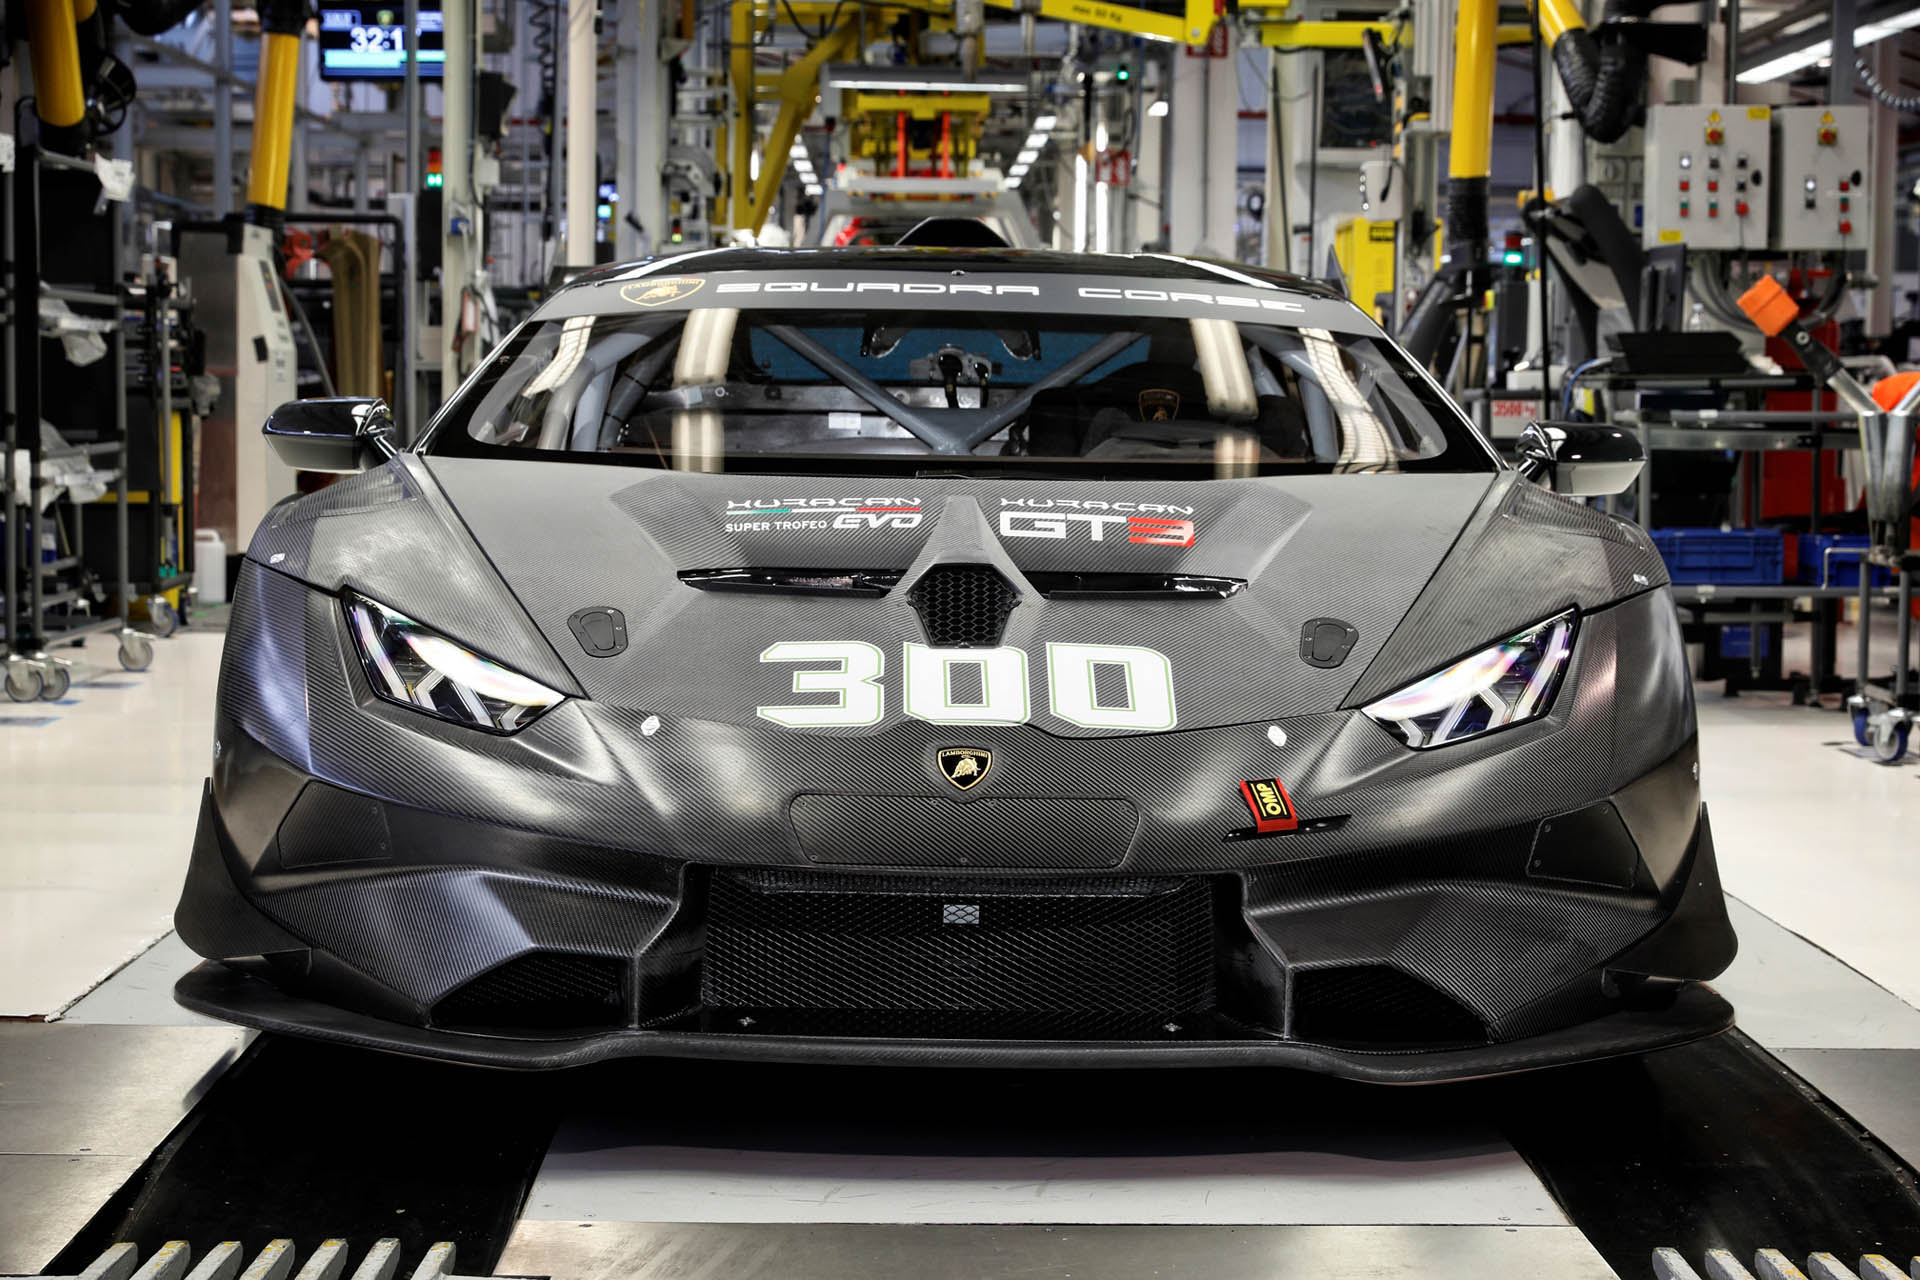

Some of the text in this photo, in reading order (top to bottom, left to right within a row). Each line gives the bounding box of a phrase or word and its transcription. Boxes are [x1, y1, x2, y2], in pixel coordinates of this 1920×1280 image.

[716, 282, 1306, 313] SQUADRA CORSE
[725, 513, 923, 533] SUPER TROFEO EVO
[1000, 511, 1196, 547] GT3
[756, 641, 1178, 730] 300
[942, 750, 988, 758] LAMBORGHINI
[1256, 783, 1281, 815] OMP
